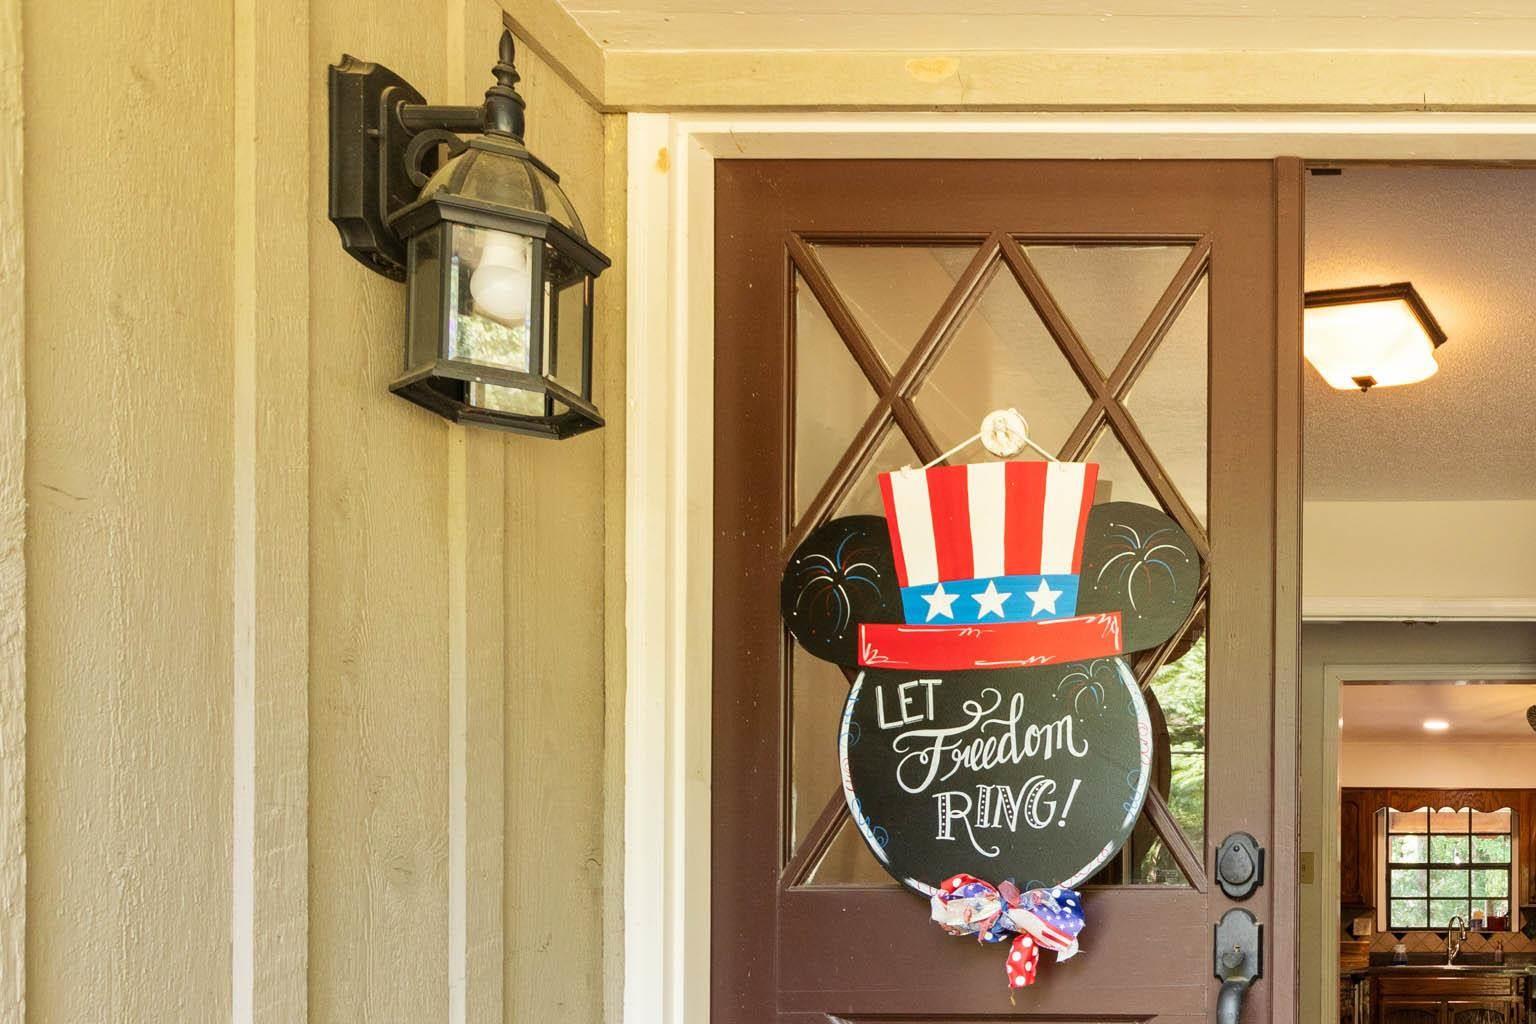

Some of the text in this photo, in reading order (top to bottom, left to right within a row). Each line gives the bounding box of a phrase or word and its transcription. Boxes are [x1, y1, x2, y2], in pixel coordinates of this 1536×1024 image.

[875, 679, 943, 730] LET
[892, 687, 1089, 794] Freedom
[932, 775, 1082, 858] RING!
